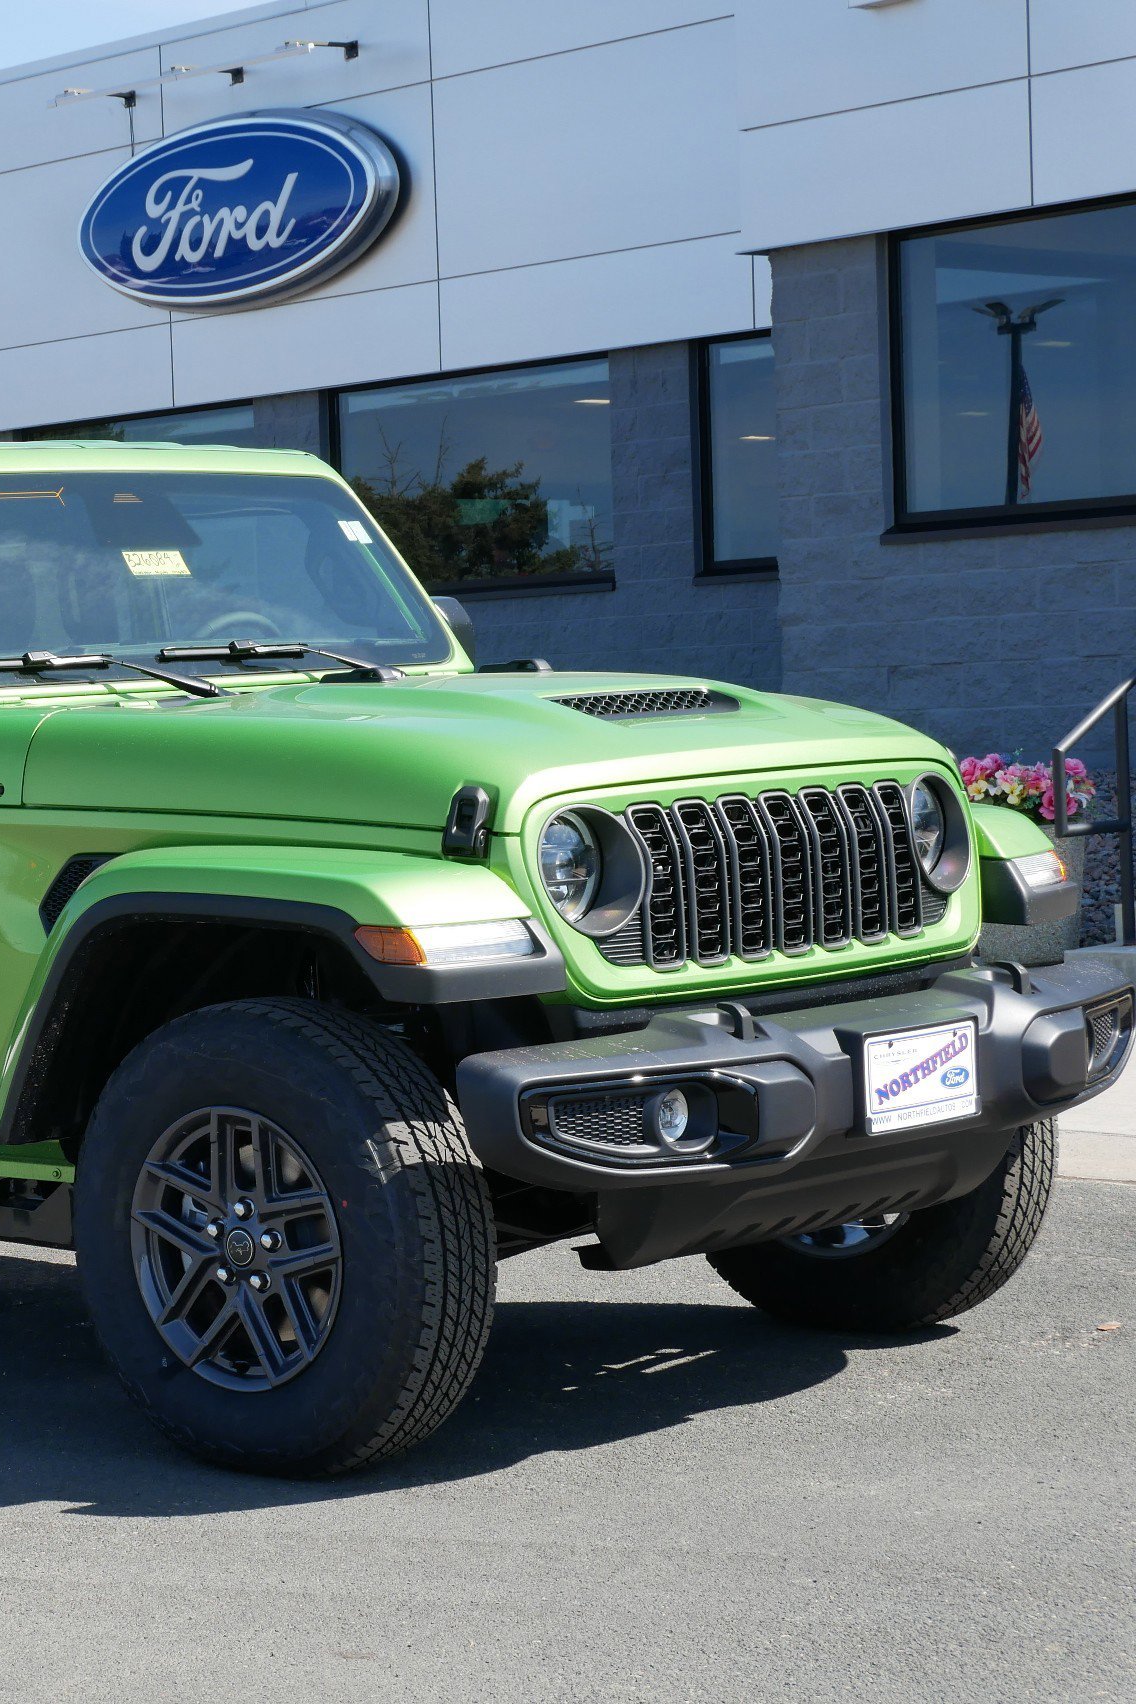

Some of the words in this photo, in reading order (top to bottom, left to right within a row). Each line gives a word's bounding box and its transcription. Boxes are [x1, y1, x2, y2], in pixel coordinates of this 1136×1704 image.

[132, 158, 298, 273] Ford
[874, 1032, 969, 1105] NORTHFIELD
[945, 1069, 965, 1086] Ford
